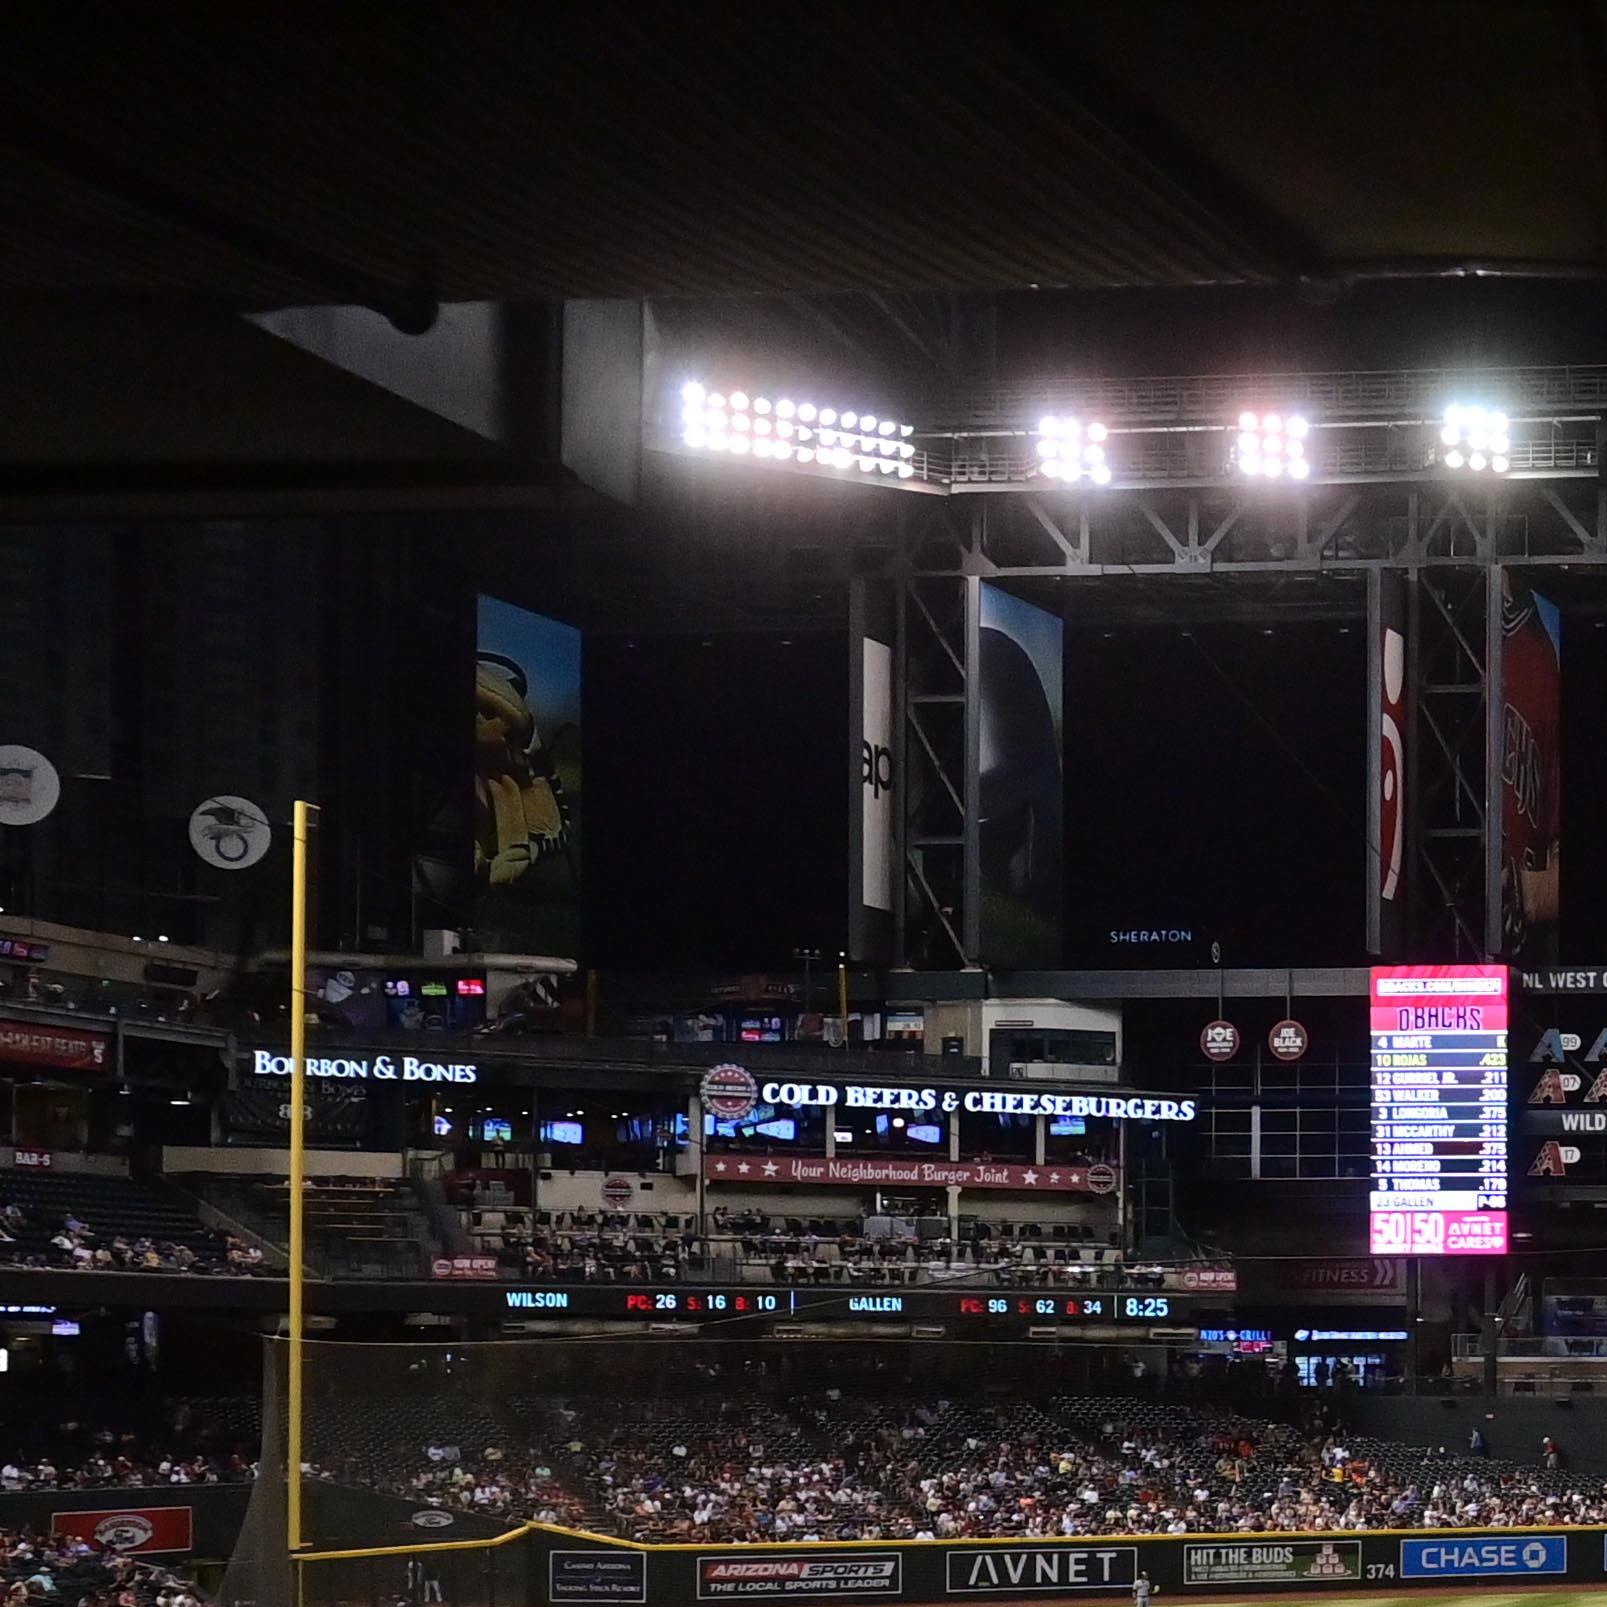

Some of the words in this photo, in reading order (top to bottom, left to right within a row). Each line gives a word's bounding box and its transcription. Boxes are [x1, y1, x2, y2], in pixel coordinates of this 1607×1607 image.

[1110, 930, 1192, 943] SHERATON
[1522, 975, 1544, 989] NL
[1550, 972, 1597, 988] WEST
[1280, 1028, 1296, 1038] JOE
[1274, 1037, 1303, 1048] BLACK
[1563, 1036, 1578, 1048] 99
[373, 1056, 398, 1080] &
[402, 1056, 477, 1083] BONES
[1562, 1075, 1578, 1088] 07
[762, 1082, 837, 1108] COLD
[845, 1086, 936, 1111] BEERS
[942, 1091, 959, 1112] &
[964, 1091, 1196, 1121] CHEESEBURGERS
[1561, 1114, 1606, 1131] WILD
[15, 1152, 51, 1166] BAR-S
[1563, 1149, 1577, 1162] 17
[791, 1161, 824, 1180] Your
[829, 1161, 918, 1181] Neighborhood
[923, 1164, 971, 1185] Burger
[974, 1165, 1008, 1184] Joint
[1393, 1197, 1434, 1207] GALLEN
[1448, 1223, 1504, 1235] AVNET
[1302, 1267, 1370, 1285] FITNESS
[506, 1292, 568, 1308] WILSON
[656, 1295, 677, 1309] 26
[707, 1295, 726, 1310] 16
[757, 1295, 776, 1310] 10
[849, 1297, 902, 1312] GALLEN
[988, 1299, 1007, 1314] 96
[1036, 1299, 1055, 1314] 62
[1083, 1300, 1102, 1315] 34
[1126, 1297, 1168, 1318] 8:25
[1190, 1549, 1214, 1566] HIT
[1219, 1548, 1248, 1565] THE
[1252, 1547, 1294, 1564] BUDS
[1421, 1545, 1517, 1569] CHASE
[712, 1562, 799, 1577] ARIZONA
[805, 1562, 887, 1577] SPORTS
[968, 1551, 1117, 1586] AVNET
[1366, 1563, 1395, 1580] 374
[710, 1583, 734, 1593] THE
[738, 1582, 781, 1592] LOCAL
[785, 1580, 837, 1590] SPORTS
[840, 1578, 889, 1588] LEADER
